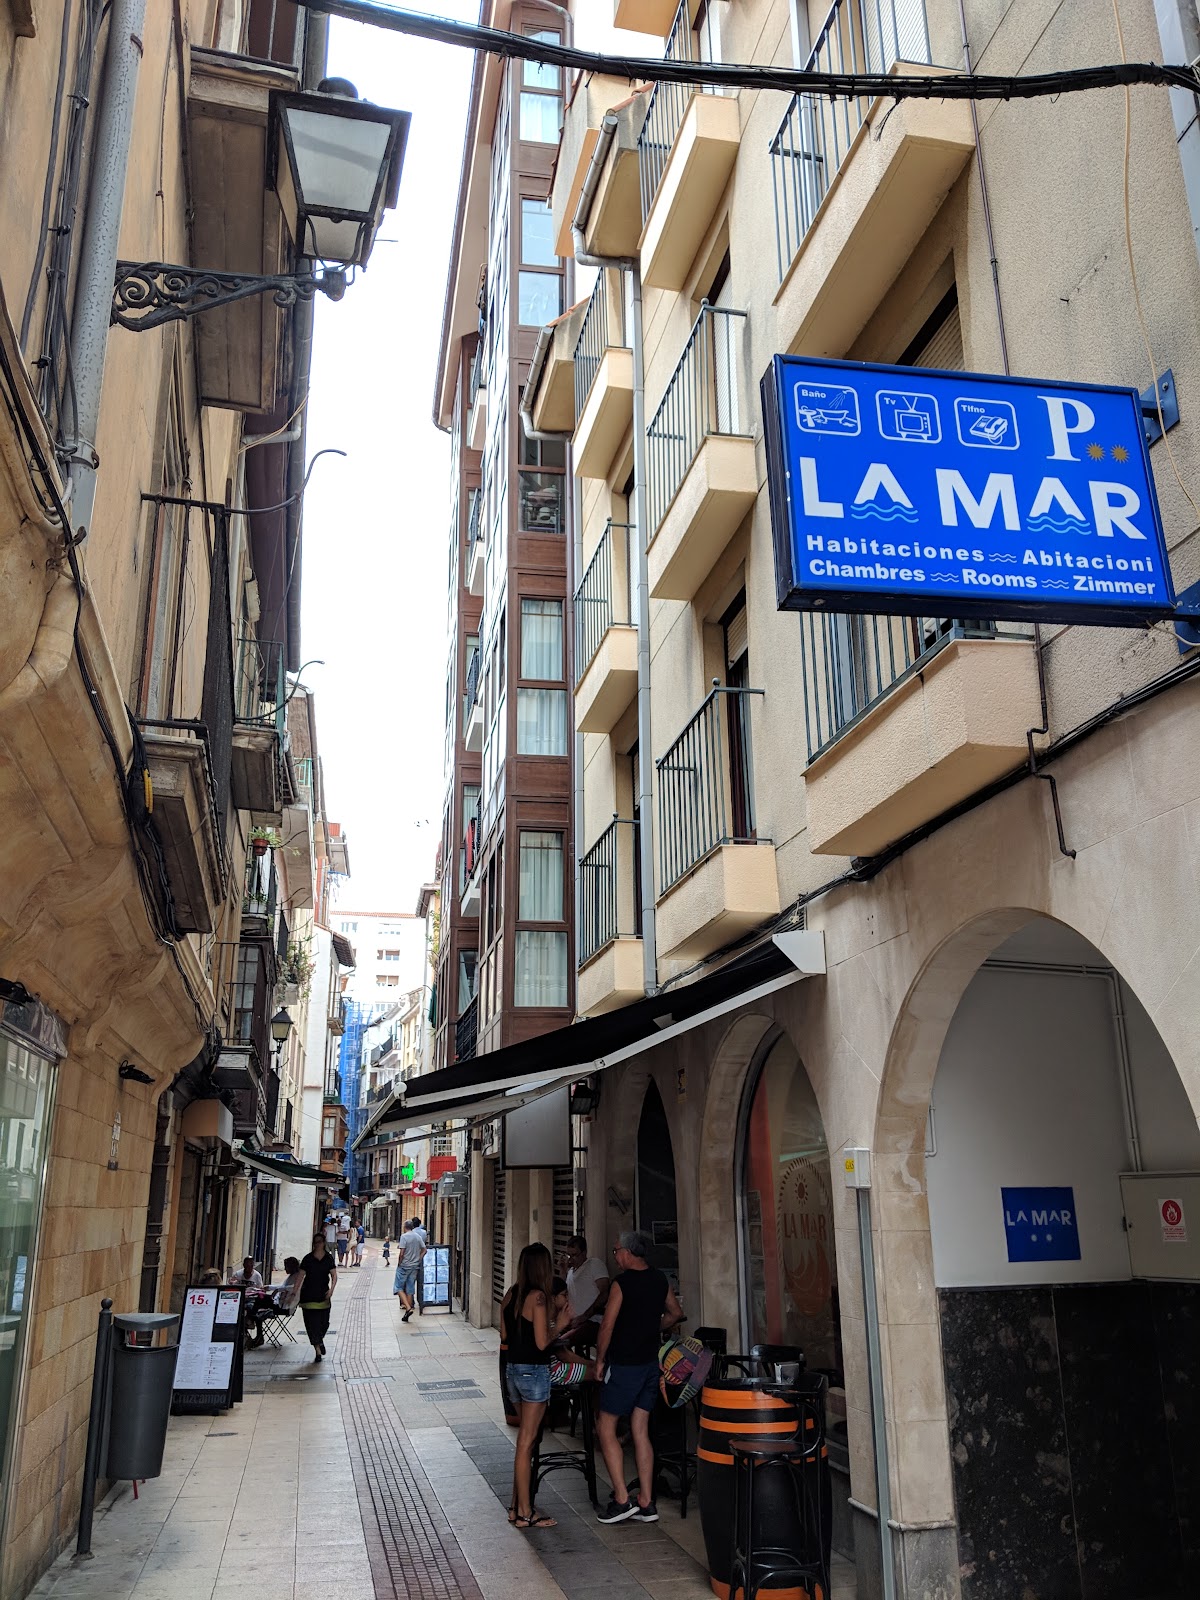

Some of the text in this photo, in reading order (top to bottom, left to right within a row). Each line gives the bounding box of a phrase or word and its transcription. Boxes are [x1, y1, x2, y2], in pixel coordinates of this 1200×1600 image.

[801, 388, 826, 399] Baño
[884, 397, 896, 406] Tv
[1037, 395, 1095, 462] P
[799, 456, 1147, 541] LA MAR
[806, 534, 1154, 572] Habitaciones Abitacioni
[809, 559, 1156, 596] Chambres Rooms Zimmer
[784, 1213, 827, 1240] LA MAR
[1005, 1209, 1072, 1226] LA MAR
[172, 1391, 226, 1405] Cruzcampo
